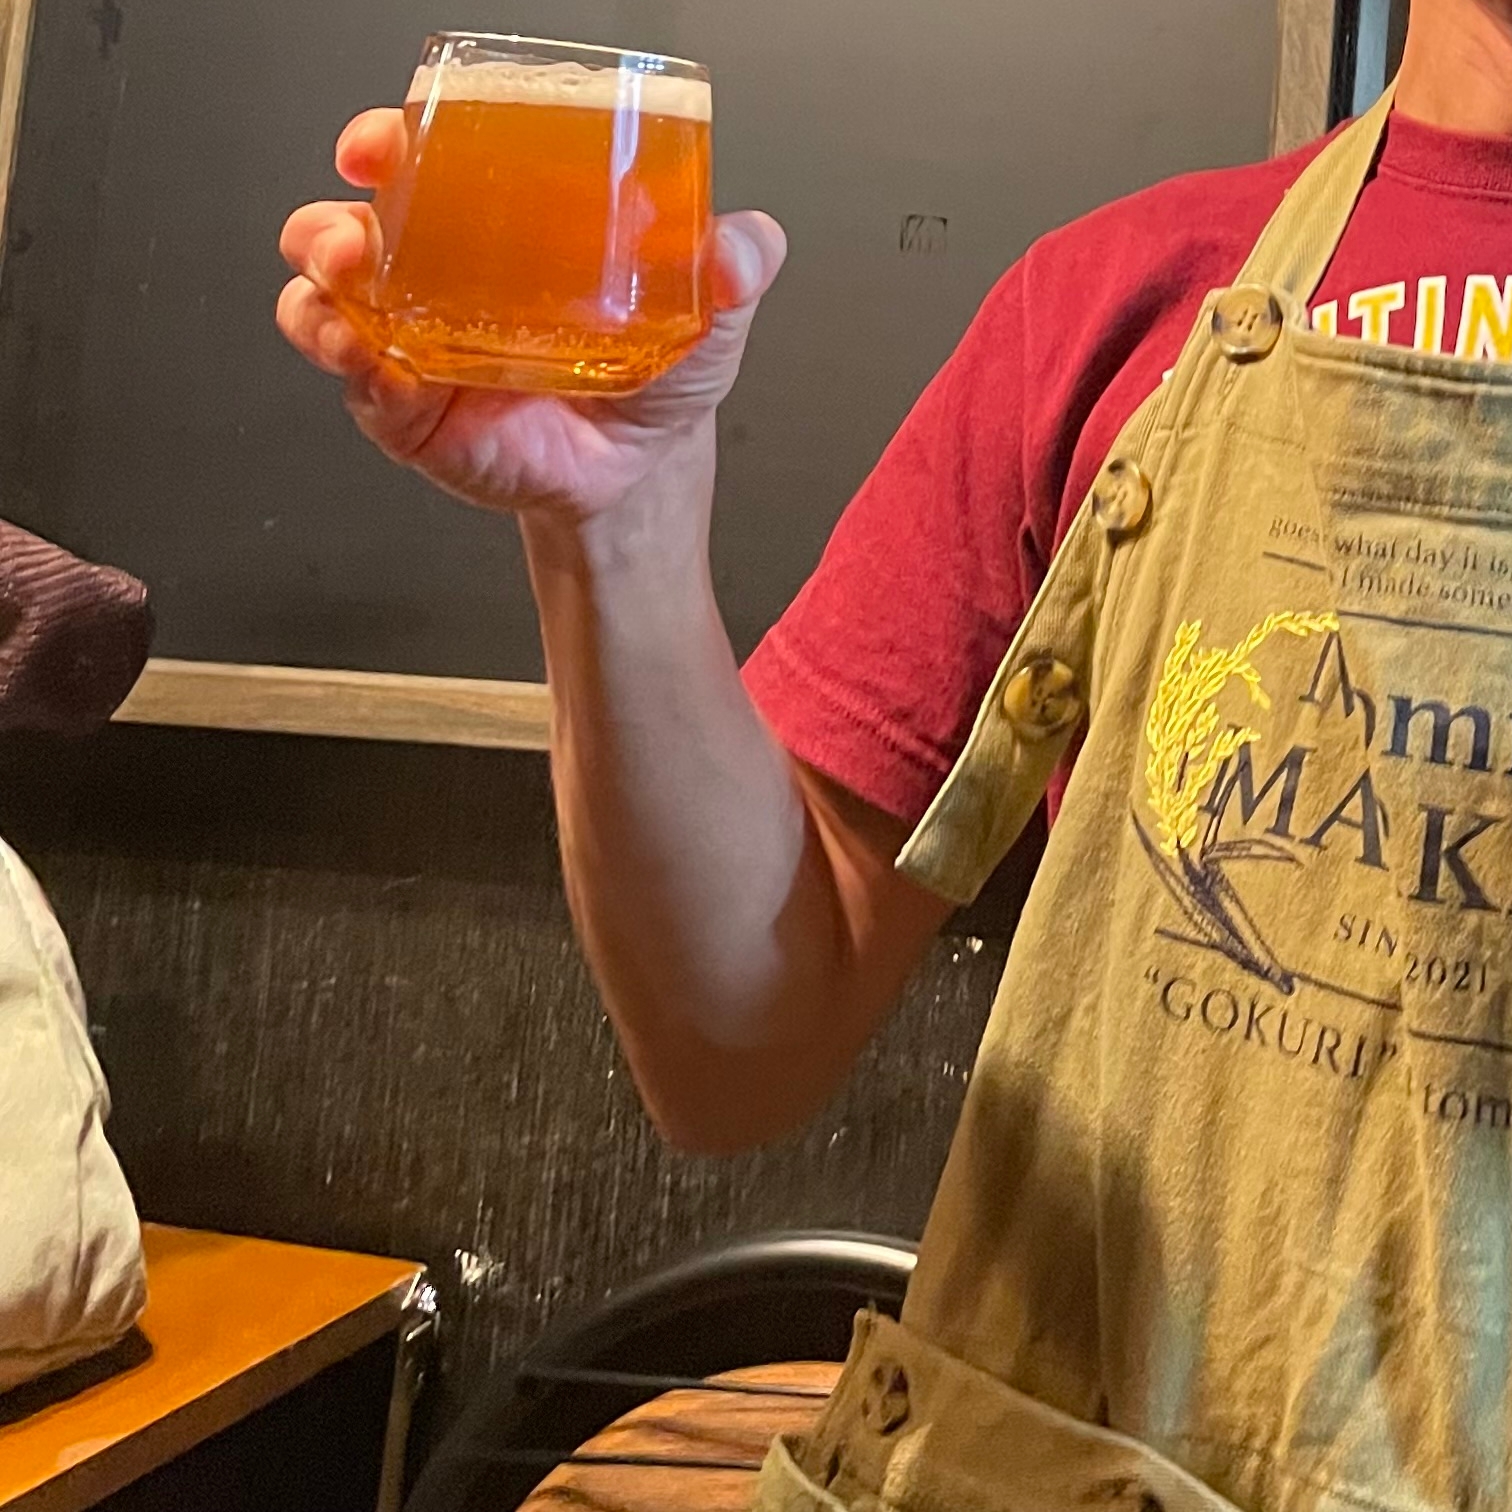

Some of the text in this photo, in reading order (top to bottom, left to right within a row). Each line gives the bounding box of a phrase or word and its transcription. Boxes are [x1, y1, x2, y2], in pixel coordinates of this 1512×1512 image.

[1334, 534, 1397, 560] what
[1405, 539, 1454, 571] day
[1359, 571, 1431, 599] made
[1332, 913, 1488, 994] SIN 2021
